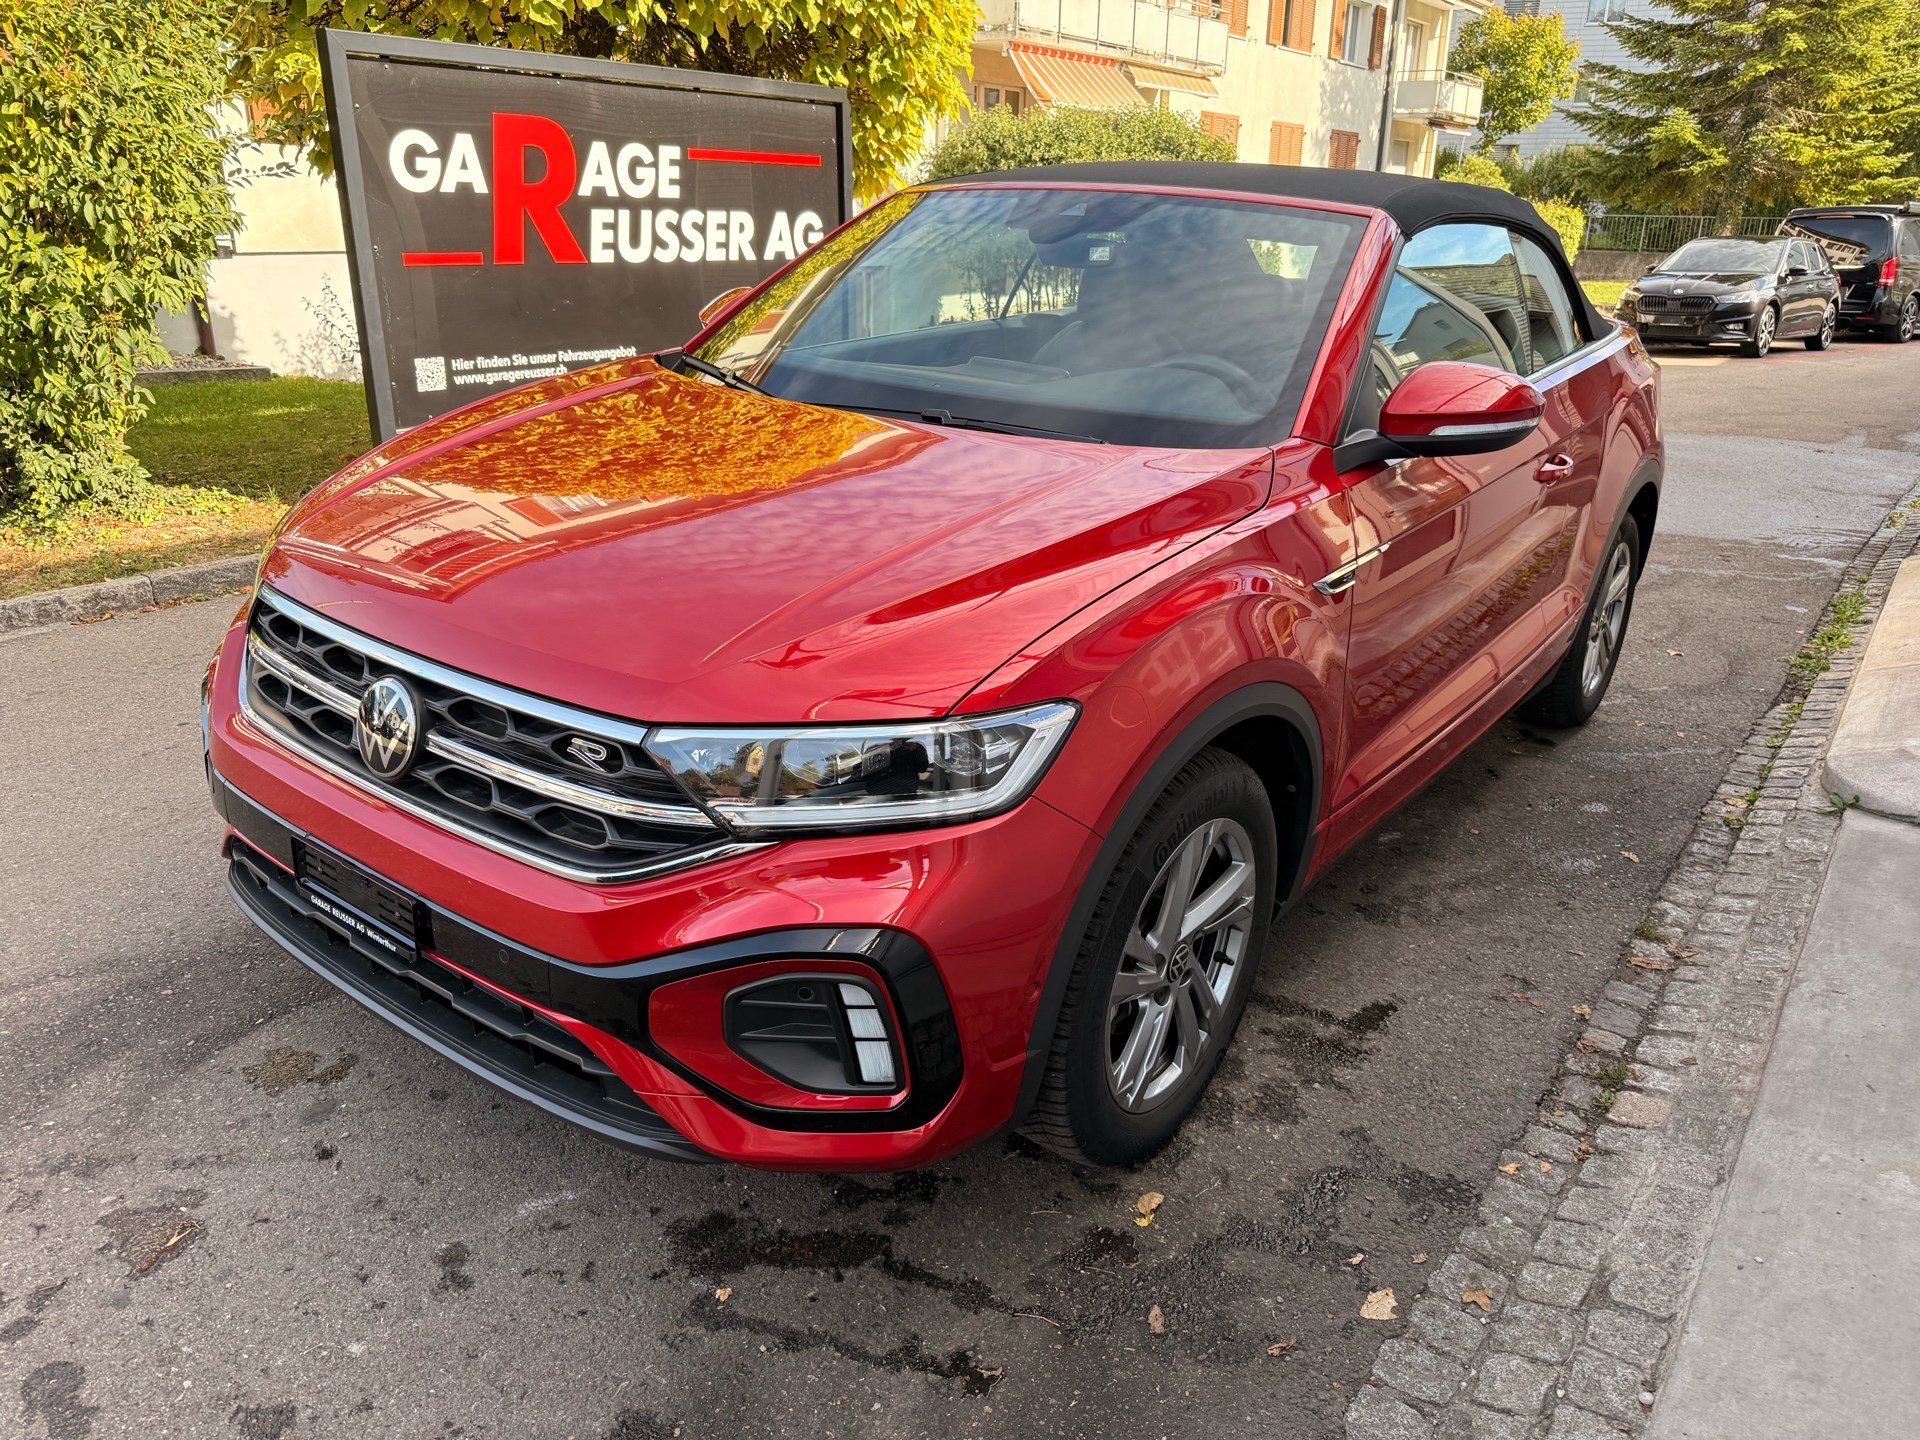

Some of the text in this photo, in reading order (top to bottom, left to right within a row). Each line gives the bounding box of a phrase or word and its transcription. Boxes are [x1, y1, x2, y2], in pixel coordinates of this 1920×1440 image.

[389, 111, 681, 264] GARAGE
[763, 210, 824, 260] AG
[452, 345, 637, 371] Hier finden Sie unser Fahrzeugangebot
[453, 364, 567, 385] www.garagereusser.ch
[311, 895, 397, 952] GARAGE REUSSER AG Winterthur
